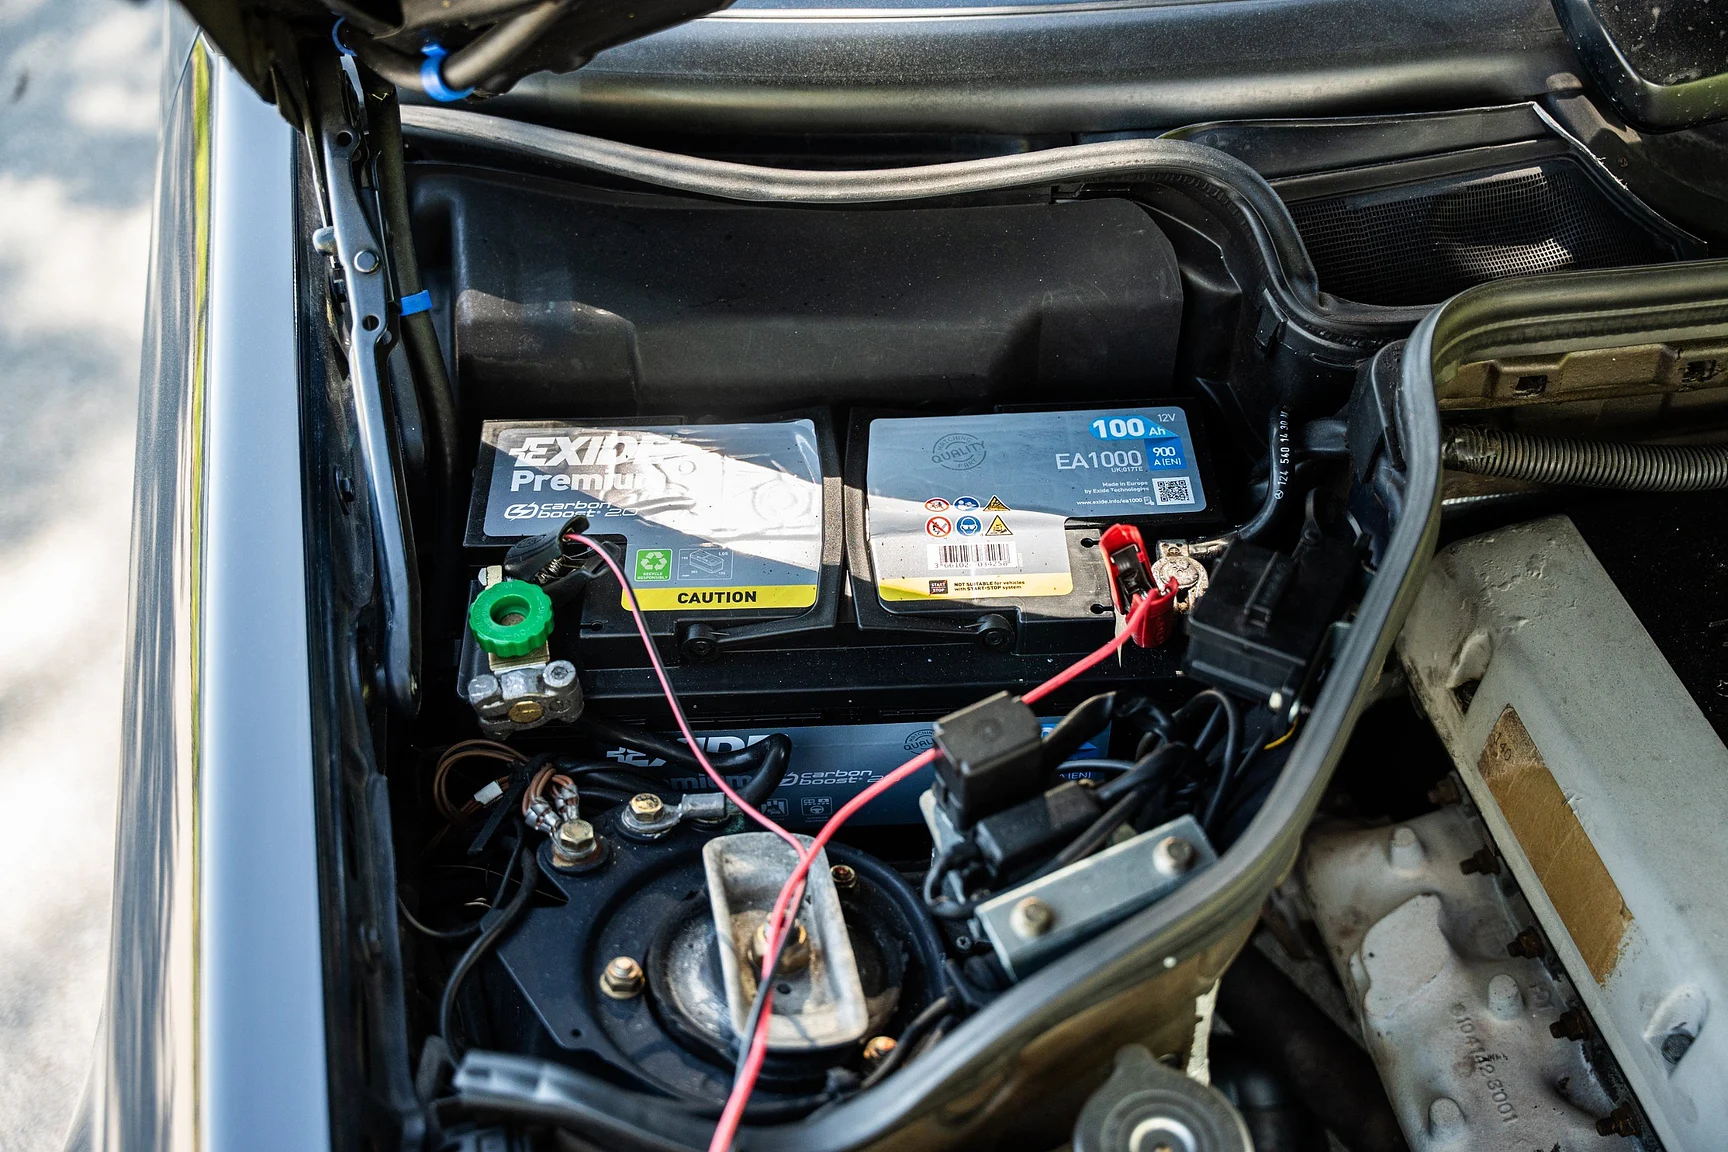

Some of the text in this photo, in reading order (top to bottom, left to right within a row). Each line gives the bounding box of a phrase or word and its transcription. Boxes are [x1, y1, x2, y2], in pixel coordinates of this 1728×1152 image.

[1158, 413, 1176, 422] 12V
[1093, 418, 1166, 438] 100 Ah
[932, 440, 985, 463] QUALITY
[1152, 446, 1176, 457] 900
[958, 458, 977, 468] PART
[1055, 450, 1143, 470] EA1000
[510, 470, 664, 492] Premiu
[1126, 480, 1148, 488] Europe
[541, 501, 613, 510] carbon
[537, 508, 639, 519] boost 2.0
[677, 591, 757, 604] CAUTION
[903, 738, 936, 751] QUALI
[801, 769, 873, 779] carbon
[799, 777, 858, 786] boost
